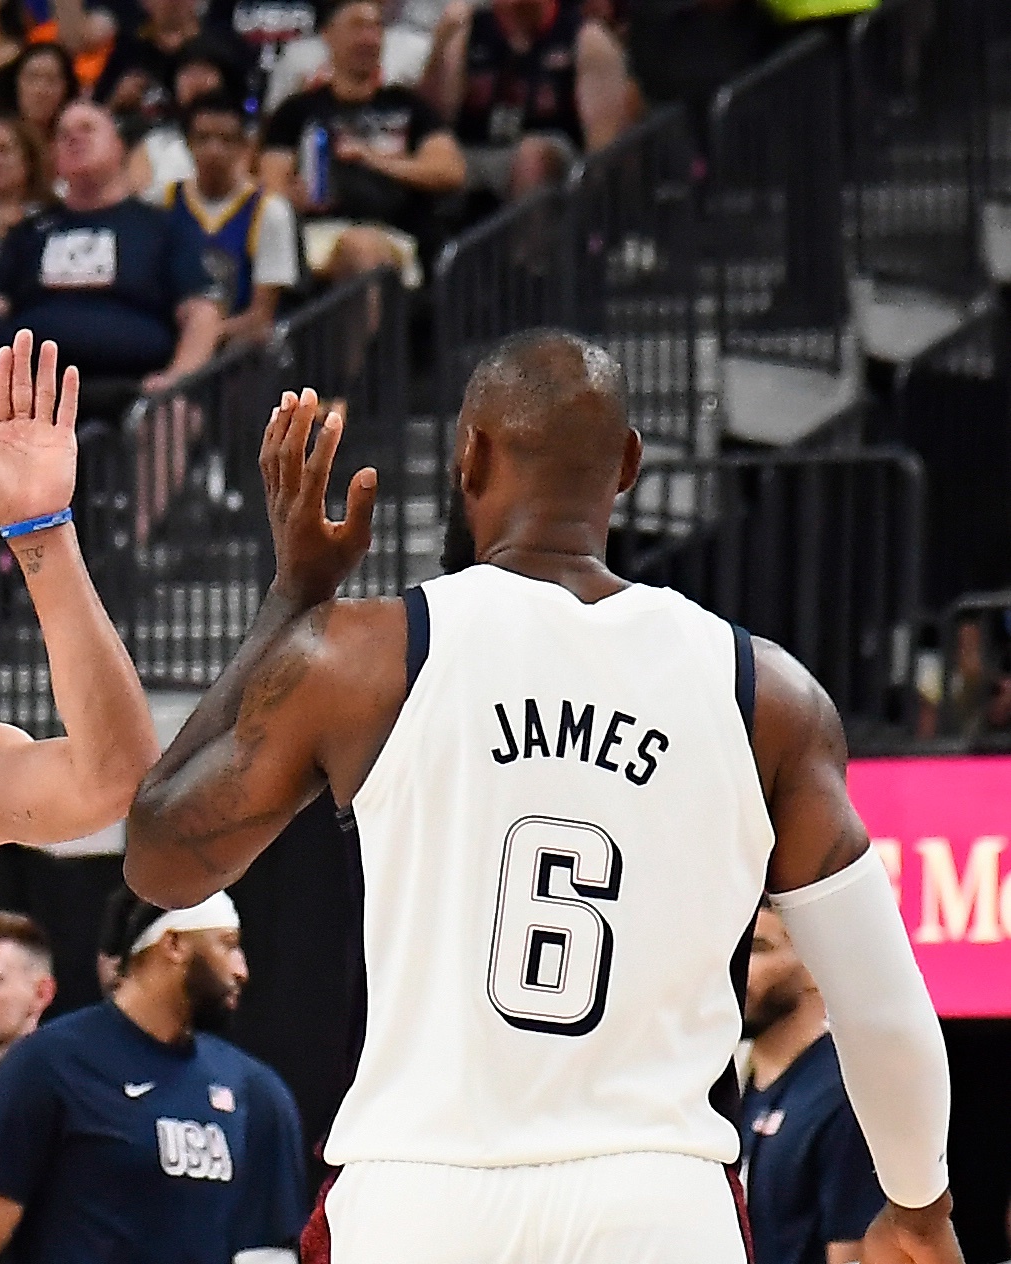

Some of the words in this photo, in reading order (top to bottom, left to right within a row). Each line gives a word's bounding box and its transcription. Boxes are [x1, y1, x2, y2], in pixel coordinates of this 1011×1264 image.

[491, 698, 669, 786] JAMES
[487, 814, 623, 1036] 6
[156, 1117, 233, 1181] USA
